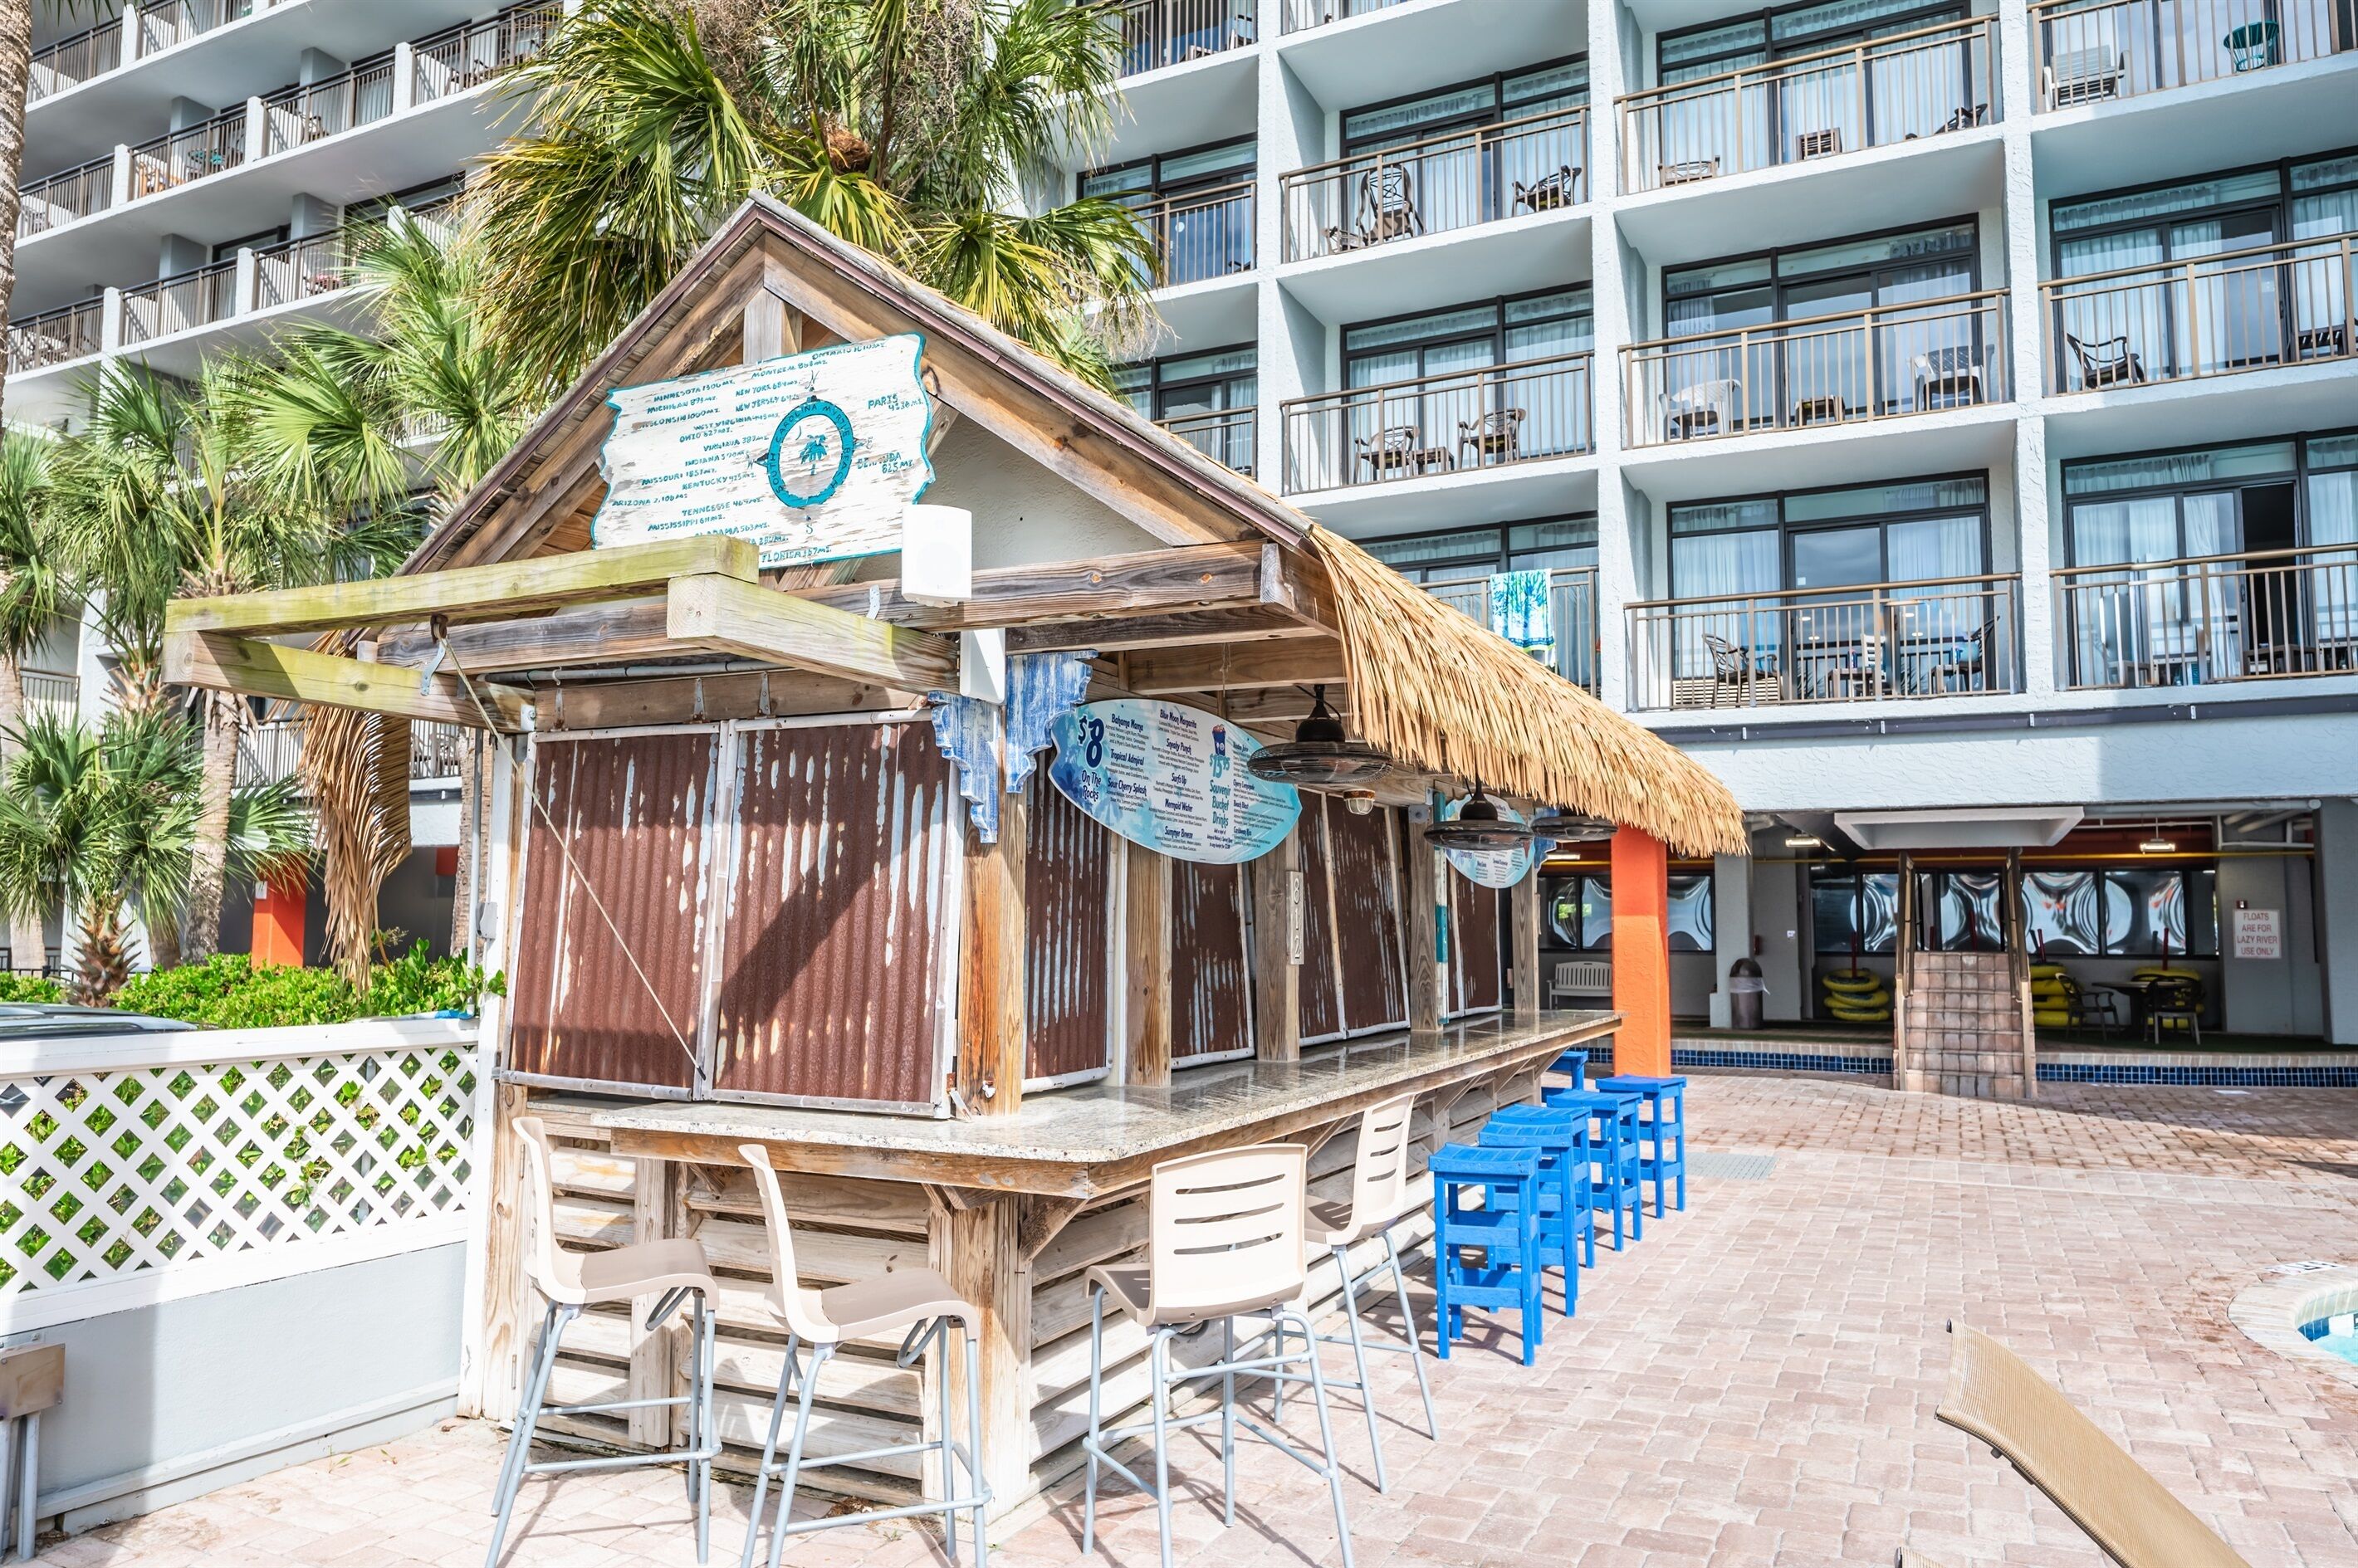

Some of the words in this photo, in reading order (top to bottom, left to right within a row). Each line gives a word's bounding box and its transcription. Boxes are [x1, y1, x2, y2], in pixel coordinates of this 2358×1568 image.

[653, 388, 701, 402] MINNESOTA
[736, 388, 751, 397] NEW
[752, 384, 771, 393] YORK
[647, 401, 688, 414] MICHIGAN
[736, 403, 751, 412] NEW
[751, 396, 779, 408] JERSEY
[868, 393, 898, 409] PARIS
[775, 403, 818, 442] CAROLINA
[823, 406, 850, 437] MYRTLE
[679, 432, 701, 442] OHIO
[685, 454, 720, 466] INDIANA
[831, 447, 850, 488] BEACH
[642, 473, 682, 486] MISSOURI
[770, 452, 784, 493] SOUTH
[682, 476, 727, 491] KENTUCKY
[648, 518, 697, 531] MISSISSIPPI
[1112, 713, 1130, 729] Bahama
[1131, 719, 1143, 732] Mama
[1180, 715, 1196, 729] Margarita
[1079, 716, 1104, 768] $8
[1181, 742, 1191, 755] Punch
[1111, 749, 1127, 761] Tropical
[1128, 753, 1145, 766] Admiral
[1082, 769, 1090, 785] On
[1092, 772, 1102, 787] The
[1172, 773, 1181, 784] Surfs
[1181, 774, 1187, 786] Up
[1083, 785, 1099, 802] Rocks
[1108, 777, 1118, 789] Sour
[1118, 779, 1133, 794] Cherry
[1133, 783, 1147, 796] Splash
[1210, 779, 1230, 798] Souvenir
[1165, 798, 1181, 811] Mermaid
[1181, 801, 1193, 812] Water
[1212, 796, 1229, 813] Bucket
[1212, 811, 1229, 828] Drinks
[1165, 826, 1180, 838] Summer
[1181, 828, 1193, 839] Breeze
[2241, 947, 2255, 955] USE
[2256, 947, 2274, 955] ONLY
